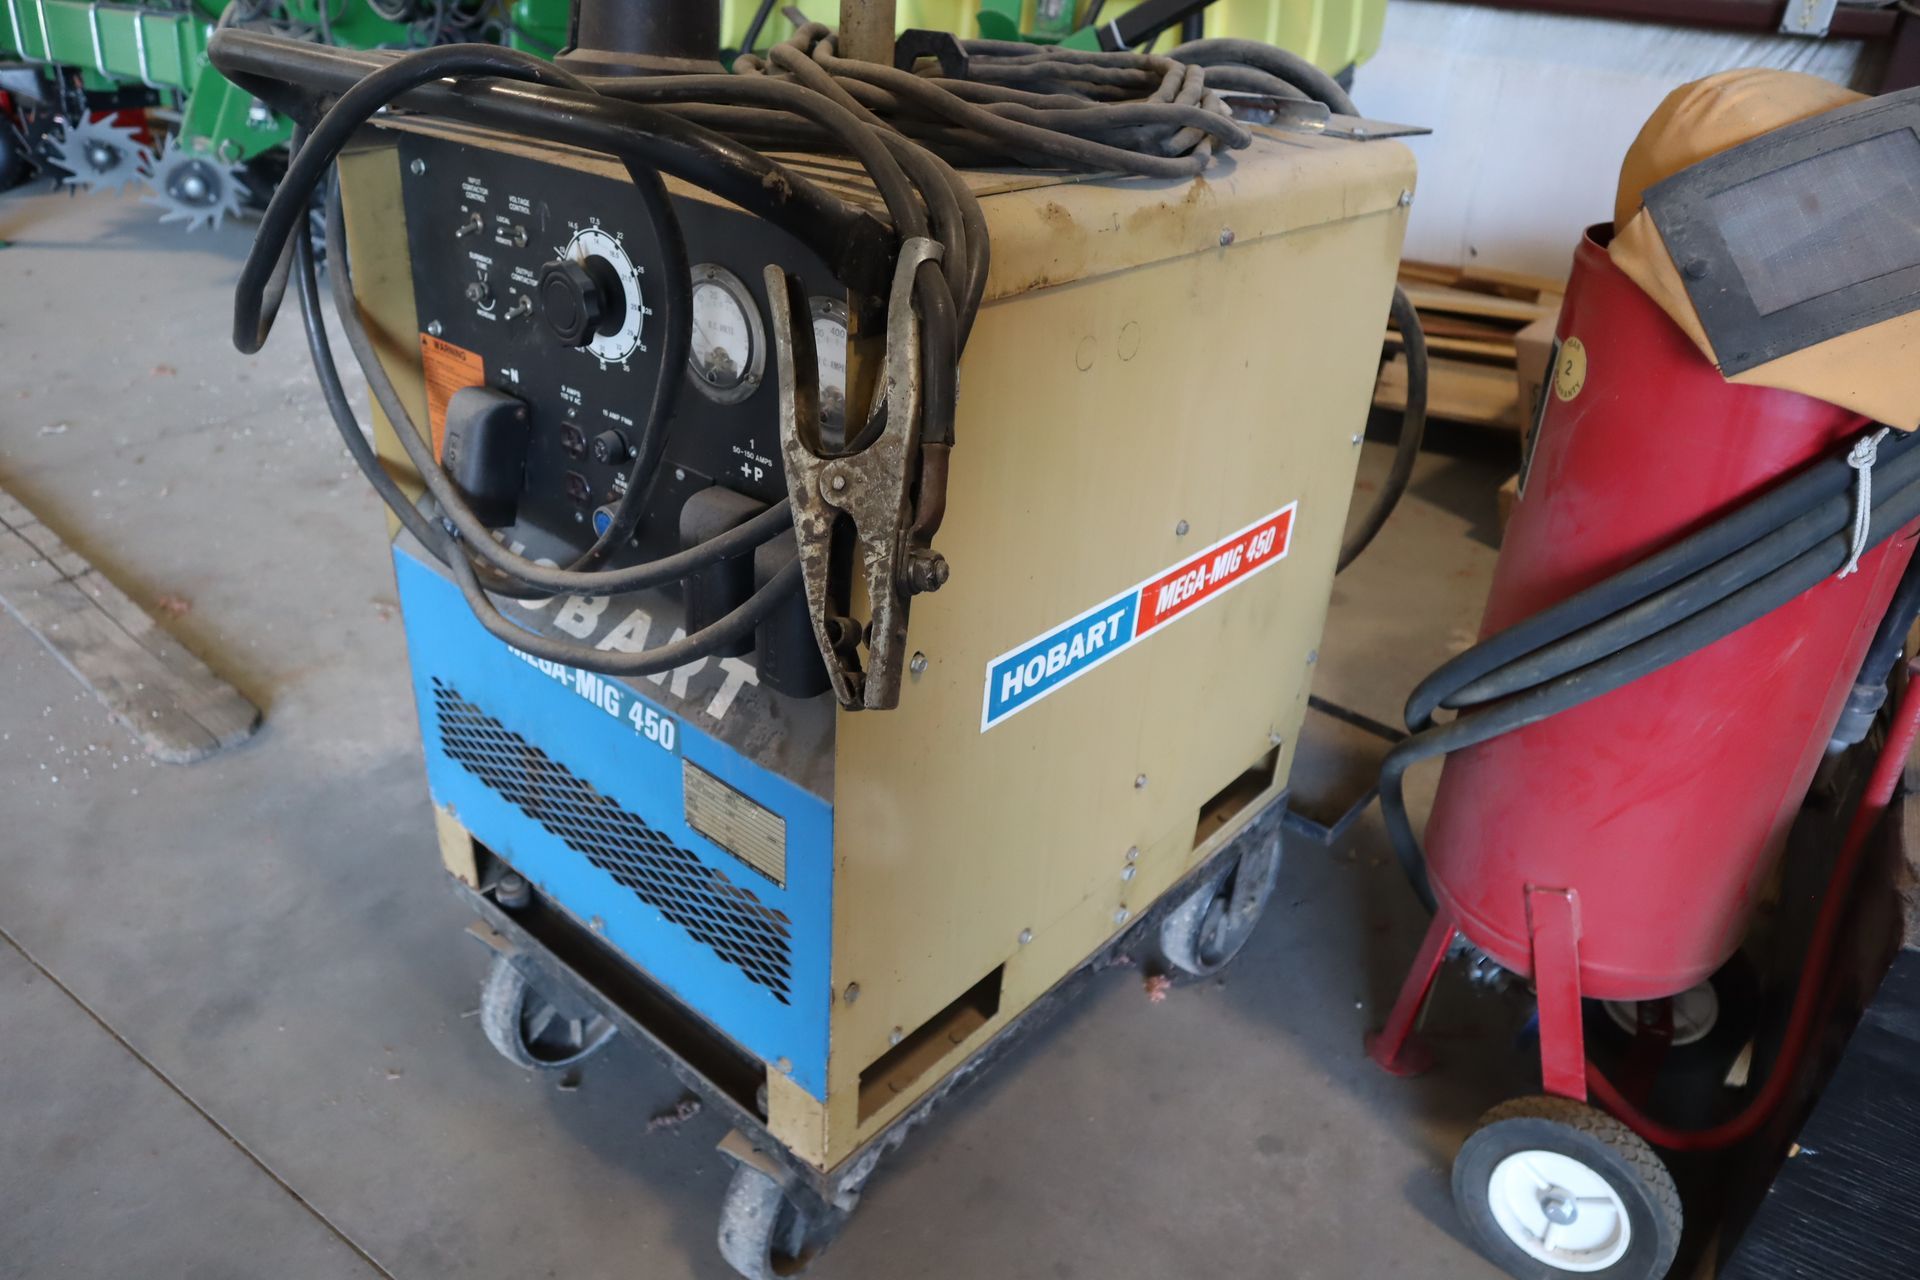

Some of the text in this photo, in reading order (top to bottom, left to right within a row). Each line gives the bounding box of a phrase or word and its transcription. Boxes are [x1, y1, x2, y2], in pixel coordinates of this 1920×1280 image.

[465, 191, 487, 203] CONTROL
[508, 195, 530, 207] VOLTAGE
[508, 203, 531, 215] CONTROL
[496, 214, 511, 225] LOCAL
[433, 339, 466, 361] WARNING
[1565, 359, 1573, 376] 2
[749, 438, 755, 450] 1
[732, 445, 773, 467] 50-150 AMPS
[1001, 525, 1277, 702] HOBART MEGA-MIG 450
[628, 701, 676, 751] 450
